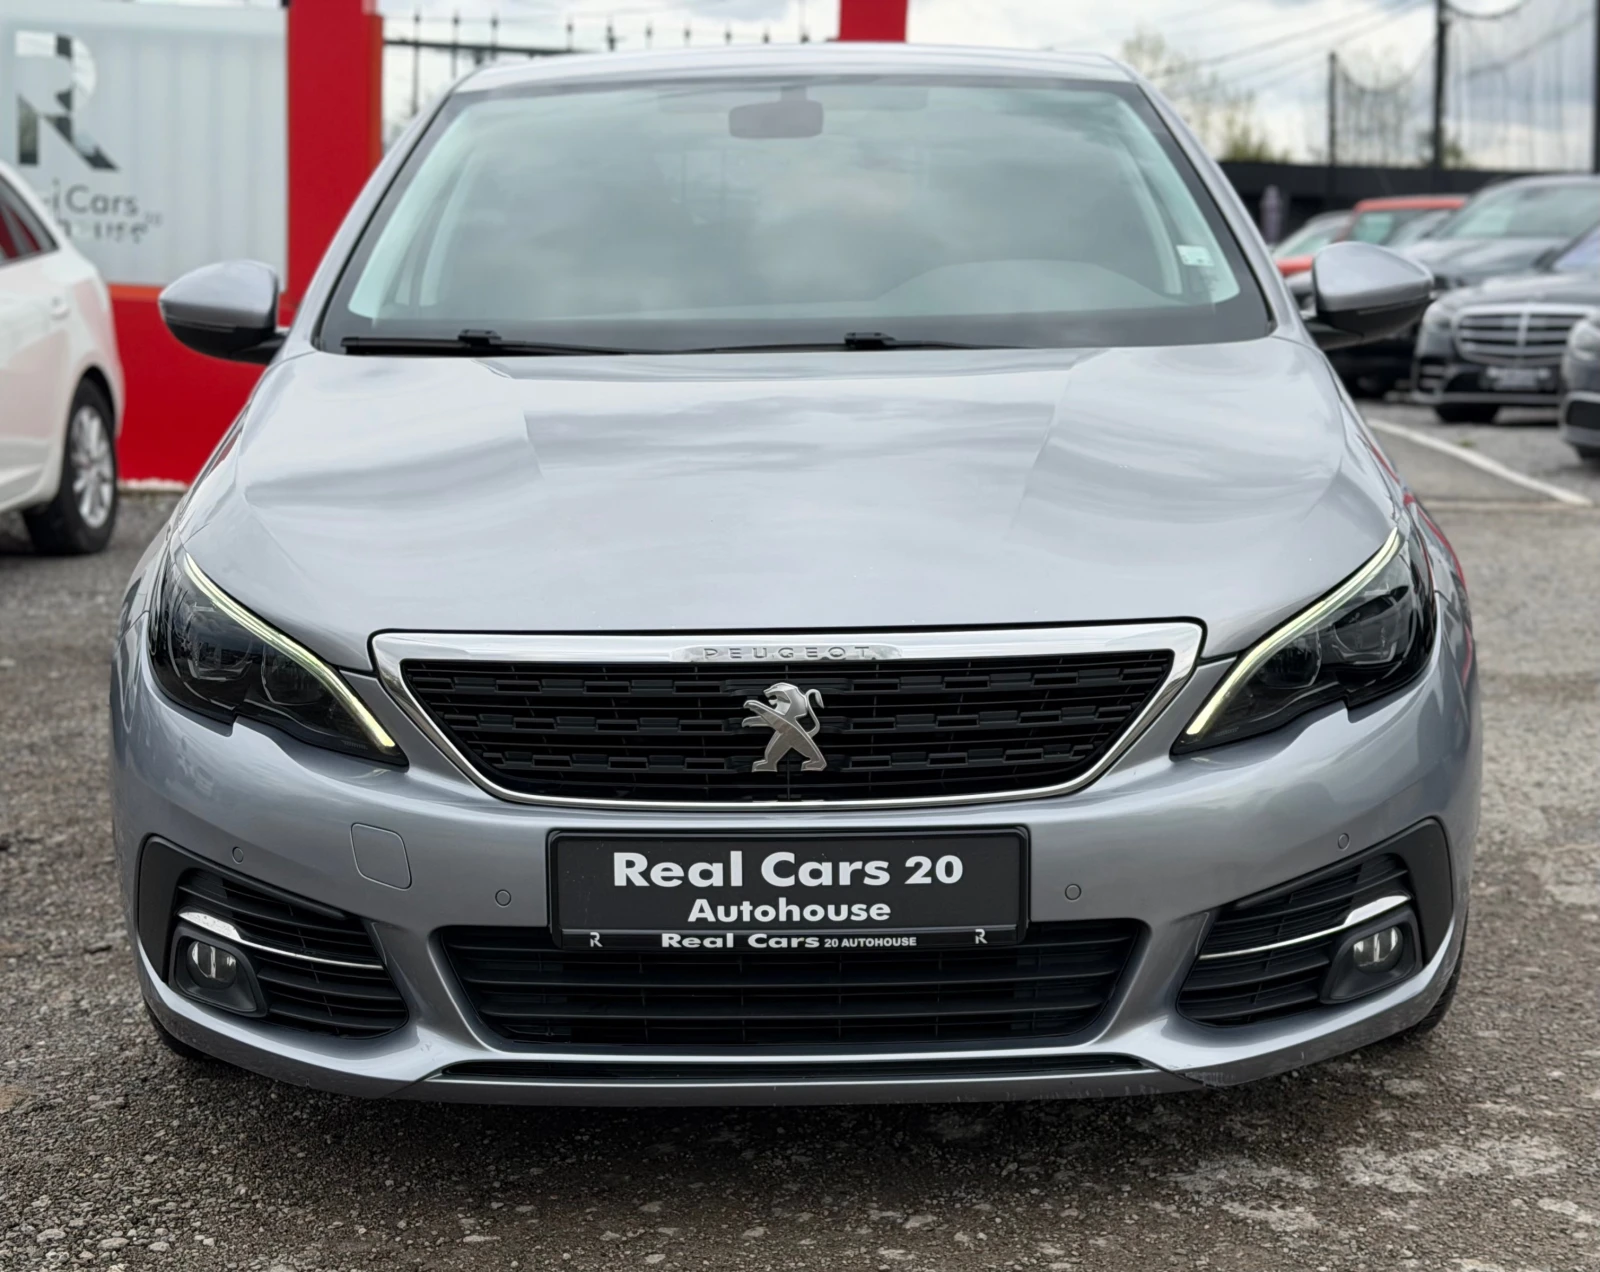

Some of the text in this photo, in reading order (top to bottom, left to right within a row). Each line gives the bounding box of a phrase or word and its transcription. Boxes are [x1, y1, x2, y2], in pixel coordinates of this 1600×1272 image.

[703, 646, 870, 660] PEUGEOT
[613, 851, 963, 887] Real Cars 20
[687, 898, 891, 923] Autohouse
[661, 933, 917, 948] Real Cars 20 AUTOHOUSE
